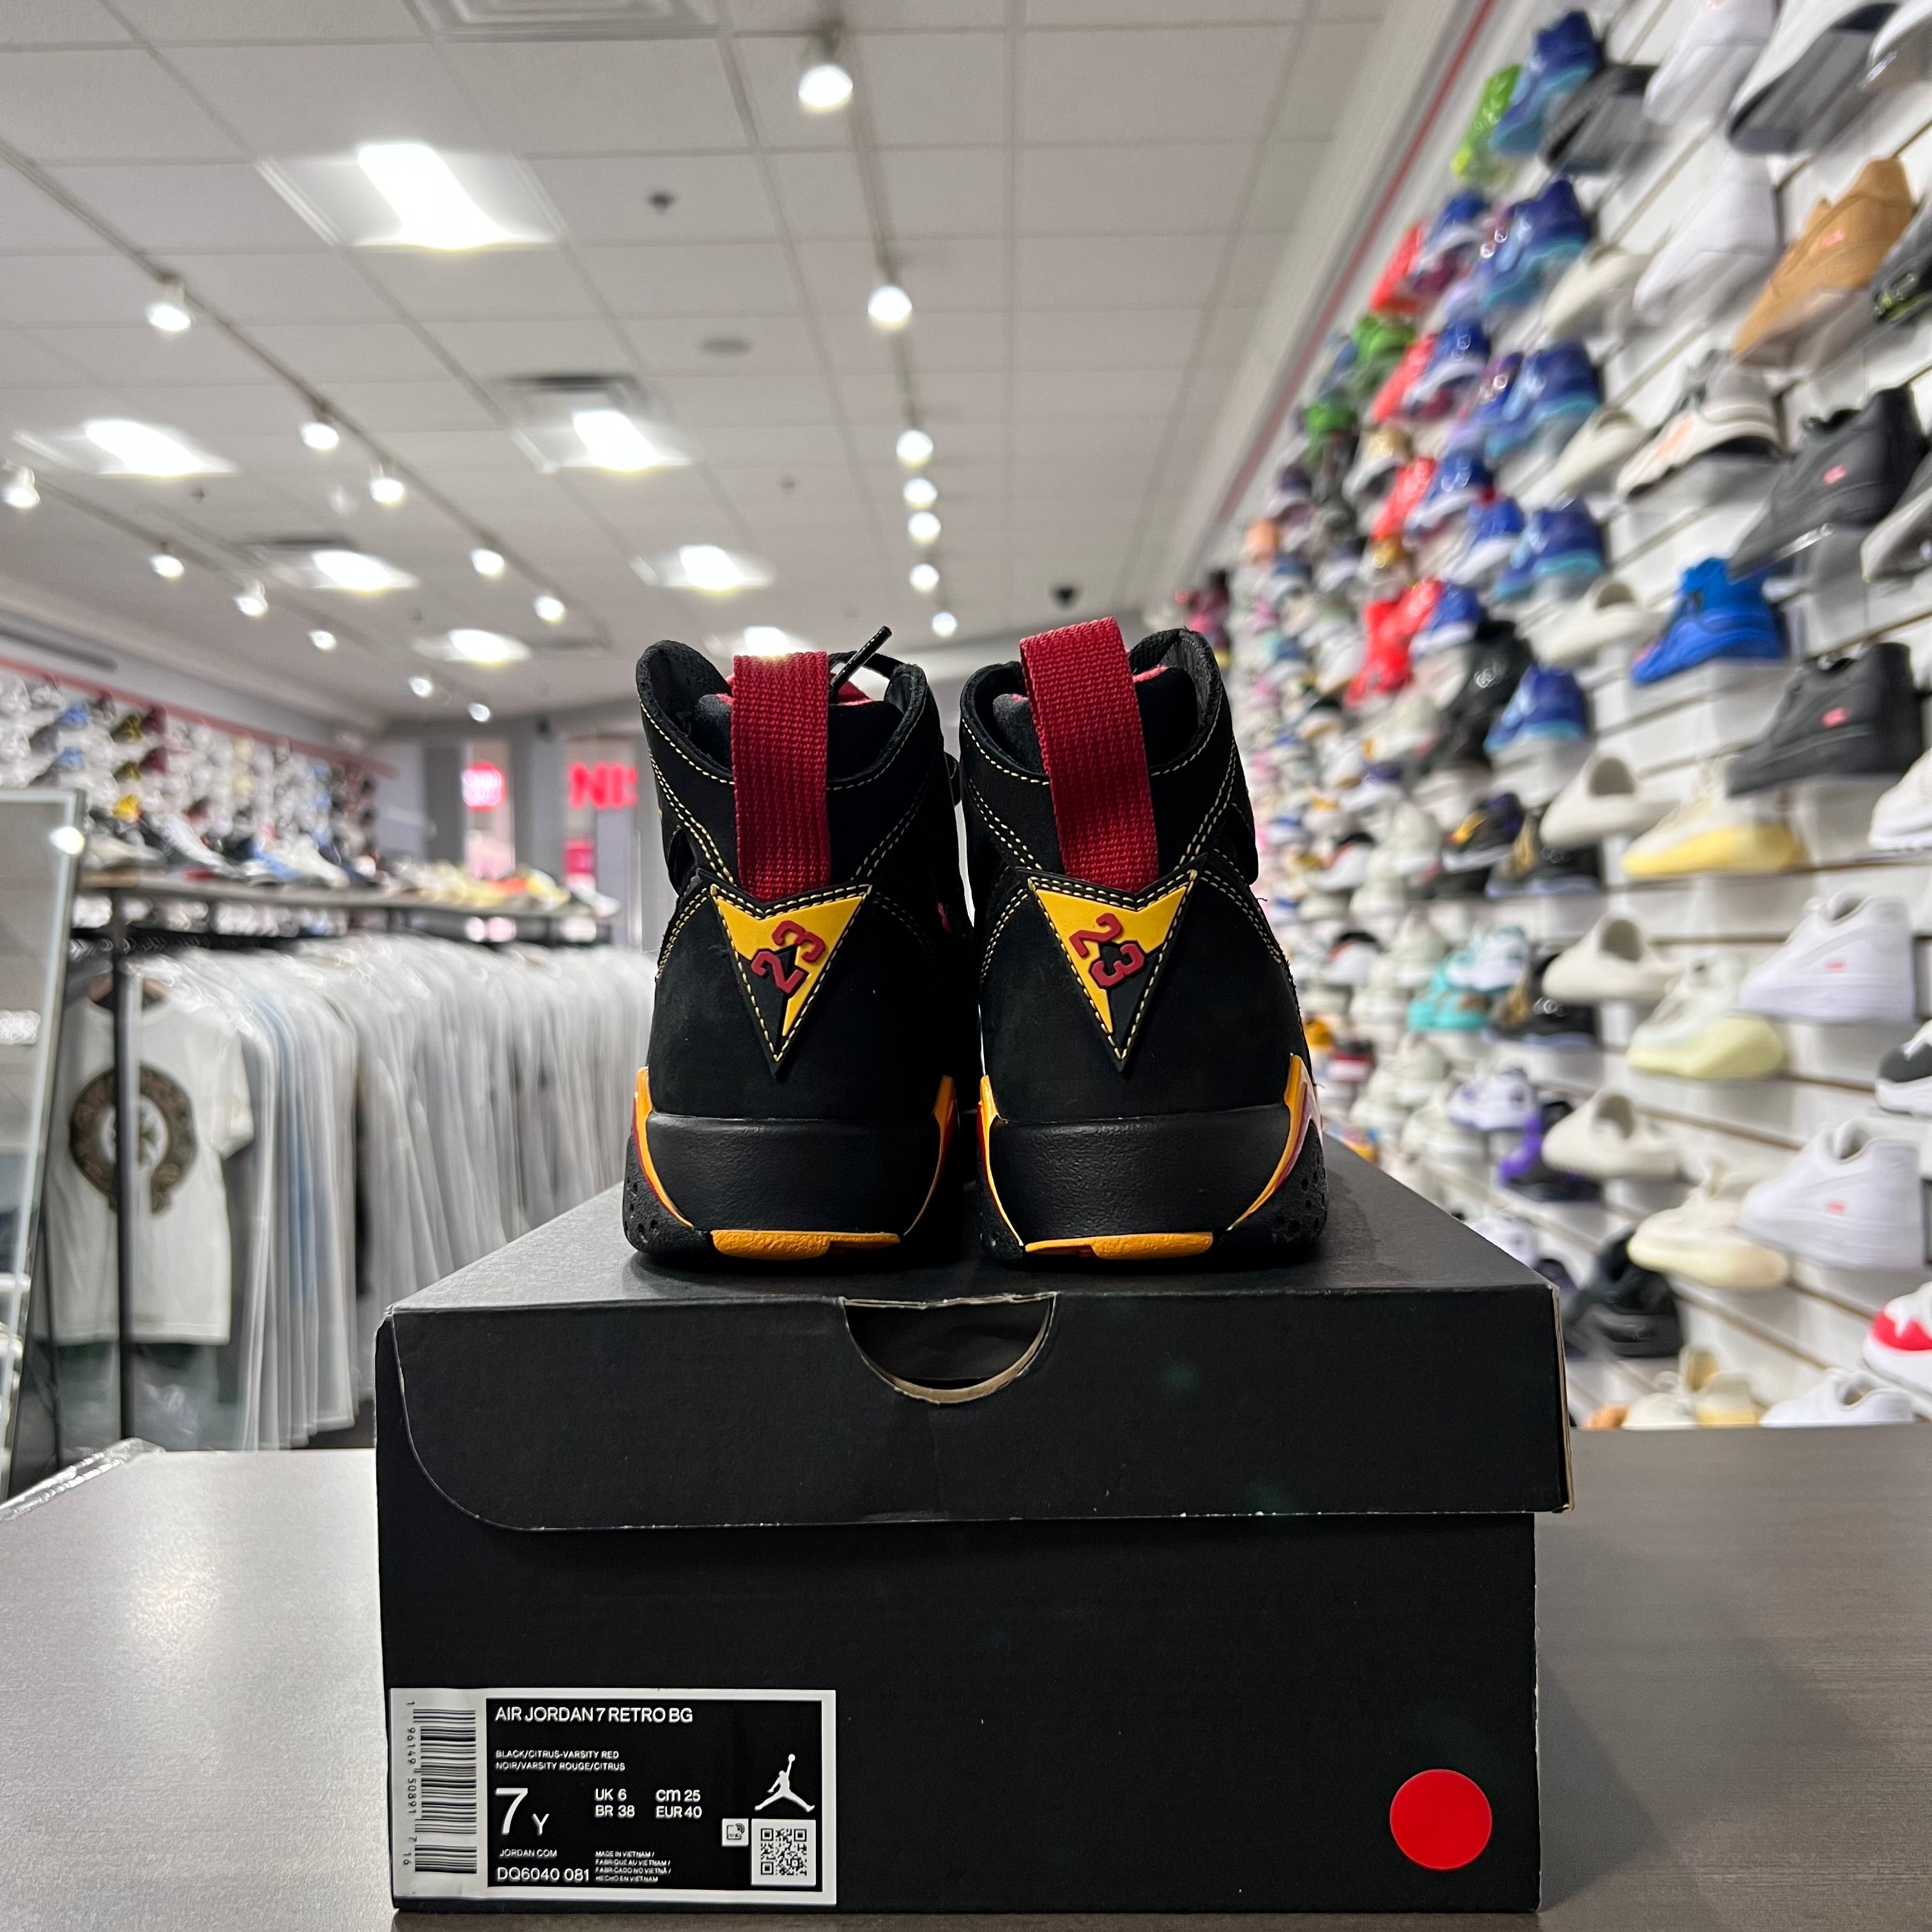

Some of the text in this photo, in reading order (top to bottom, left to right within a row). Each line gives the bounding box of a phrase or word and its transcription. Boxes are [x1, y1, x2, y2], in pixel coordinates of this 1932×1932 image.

[750, 919, 825, 994] 23
[1068, 912, 1146, 988] 23
[495, 1706, 693, 1722] AIR JORDAN 7 RETRO BG
[407, 1727, 416, 1764] 96149
[495, 1750, 619, 1759] BLACK/CITRUS-VARSITY RED
[495, 1761, 625, 1771] NOIR/VARSITY ROUGE/CITRUS
[408, 1778, 417, 1813] 50891
[595, 1788, 627, 1802] UK 6
[684, 1790, 701, 1802] 25
[495, 1788, 549, 1836] 7 Y
[595, 1805, 635, 1818] BR 38
[656, 1805, 702, 1819] EUR 40
[497, 1867, 589, 1882] DQ6040 081
